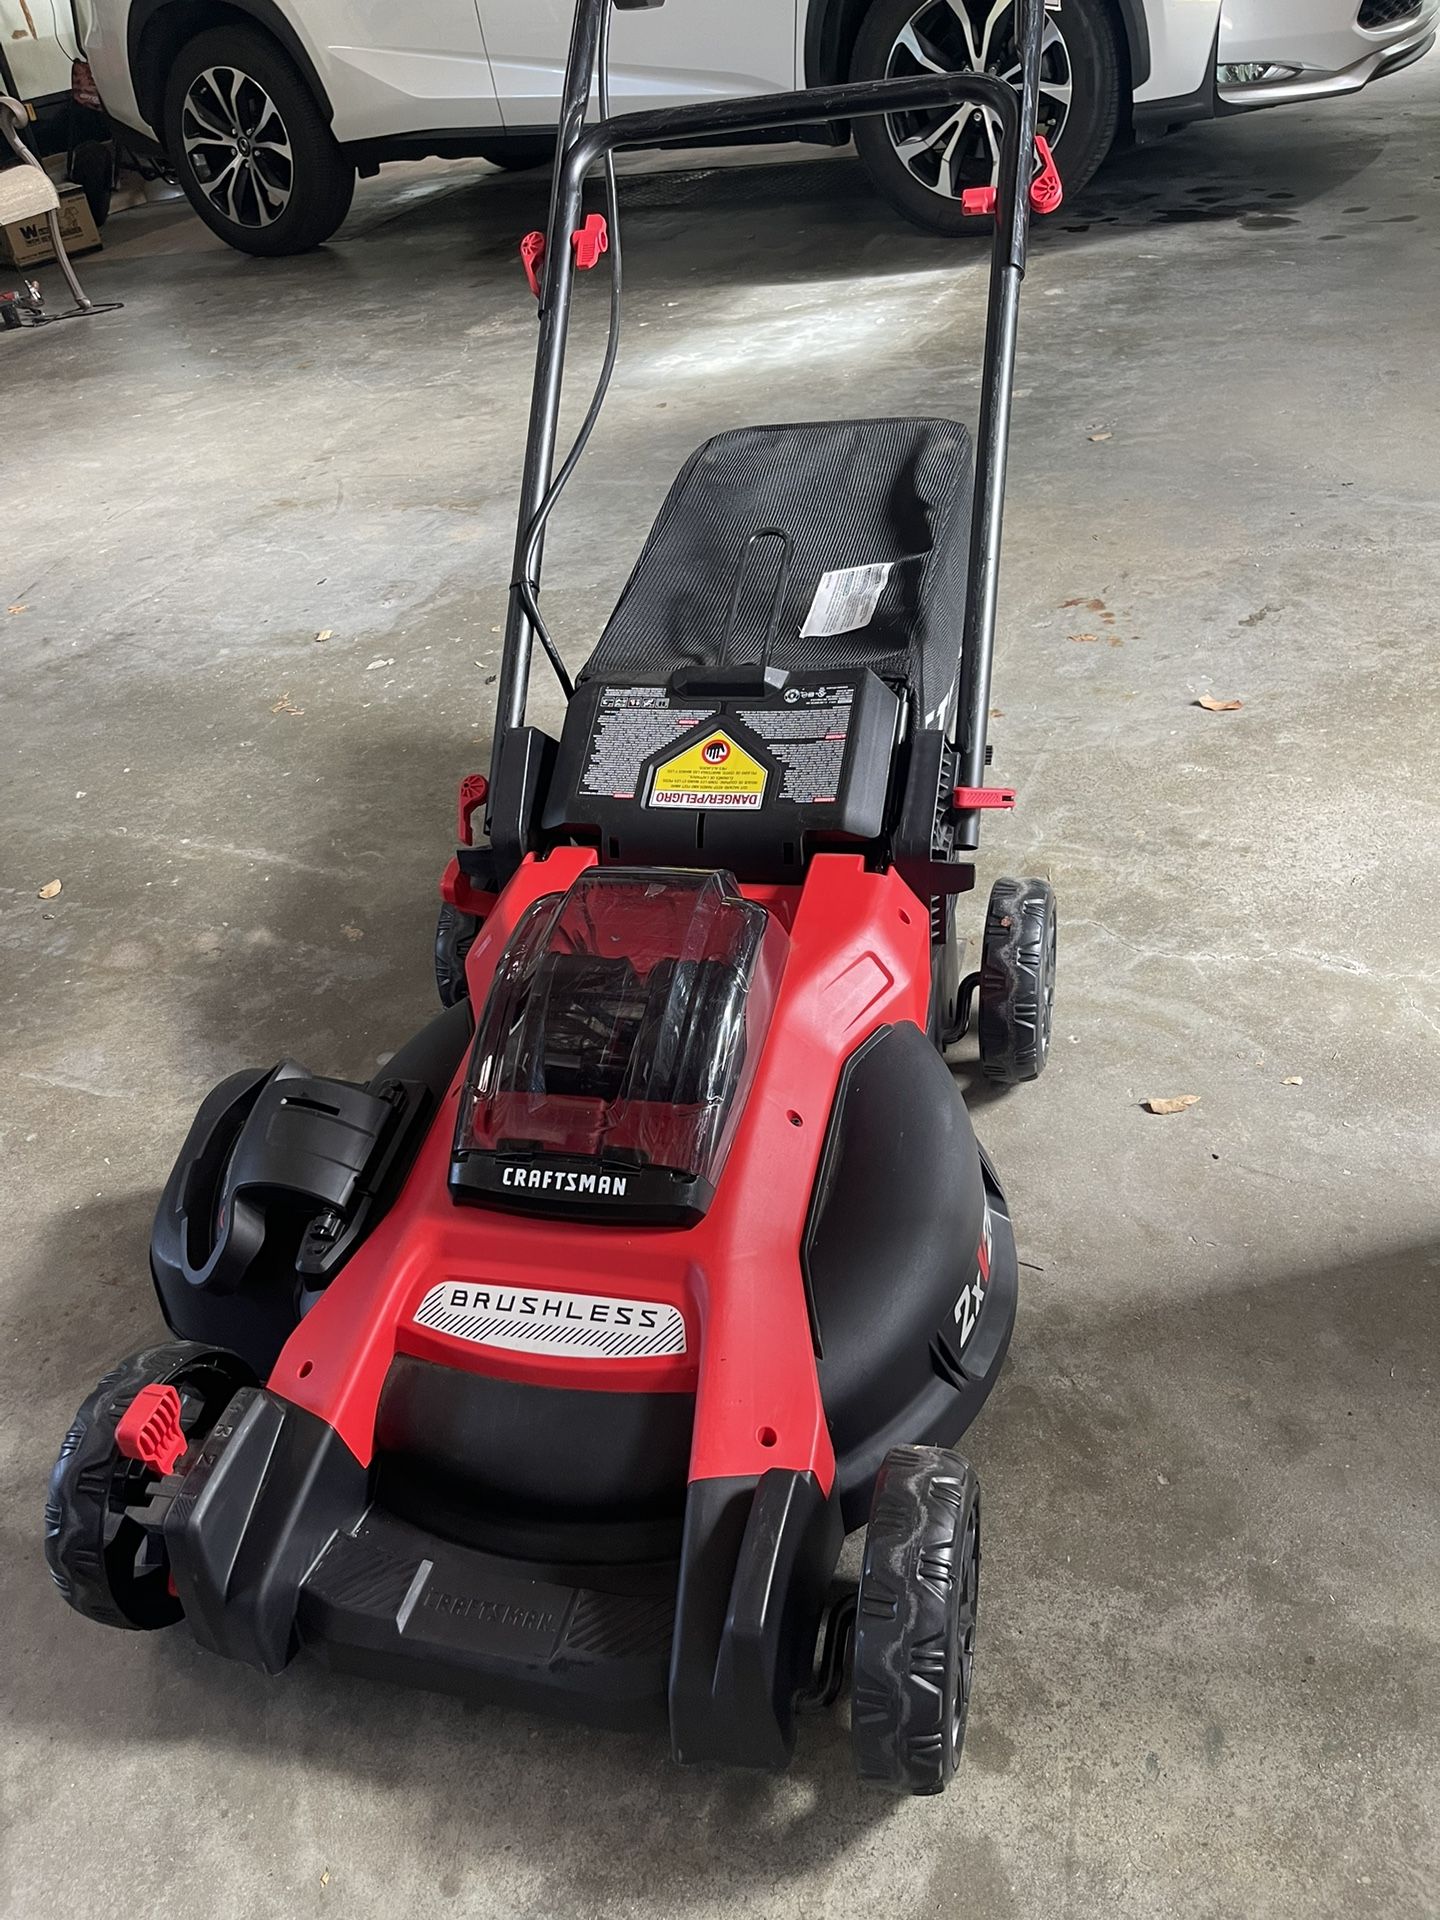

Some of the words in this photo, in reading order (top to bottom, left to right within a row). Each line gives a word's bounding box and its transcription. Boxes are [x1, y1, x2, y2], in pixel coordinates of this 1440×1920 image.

[656, 792, 758, 805] DANGER/PELIGRO
[502, 1167, 627, 1196] CRAFTSMAN
[450, 1289, 658, 1328] BRUSHLESS
